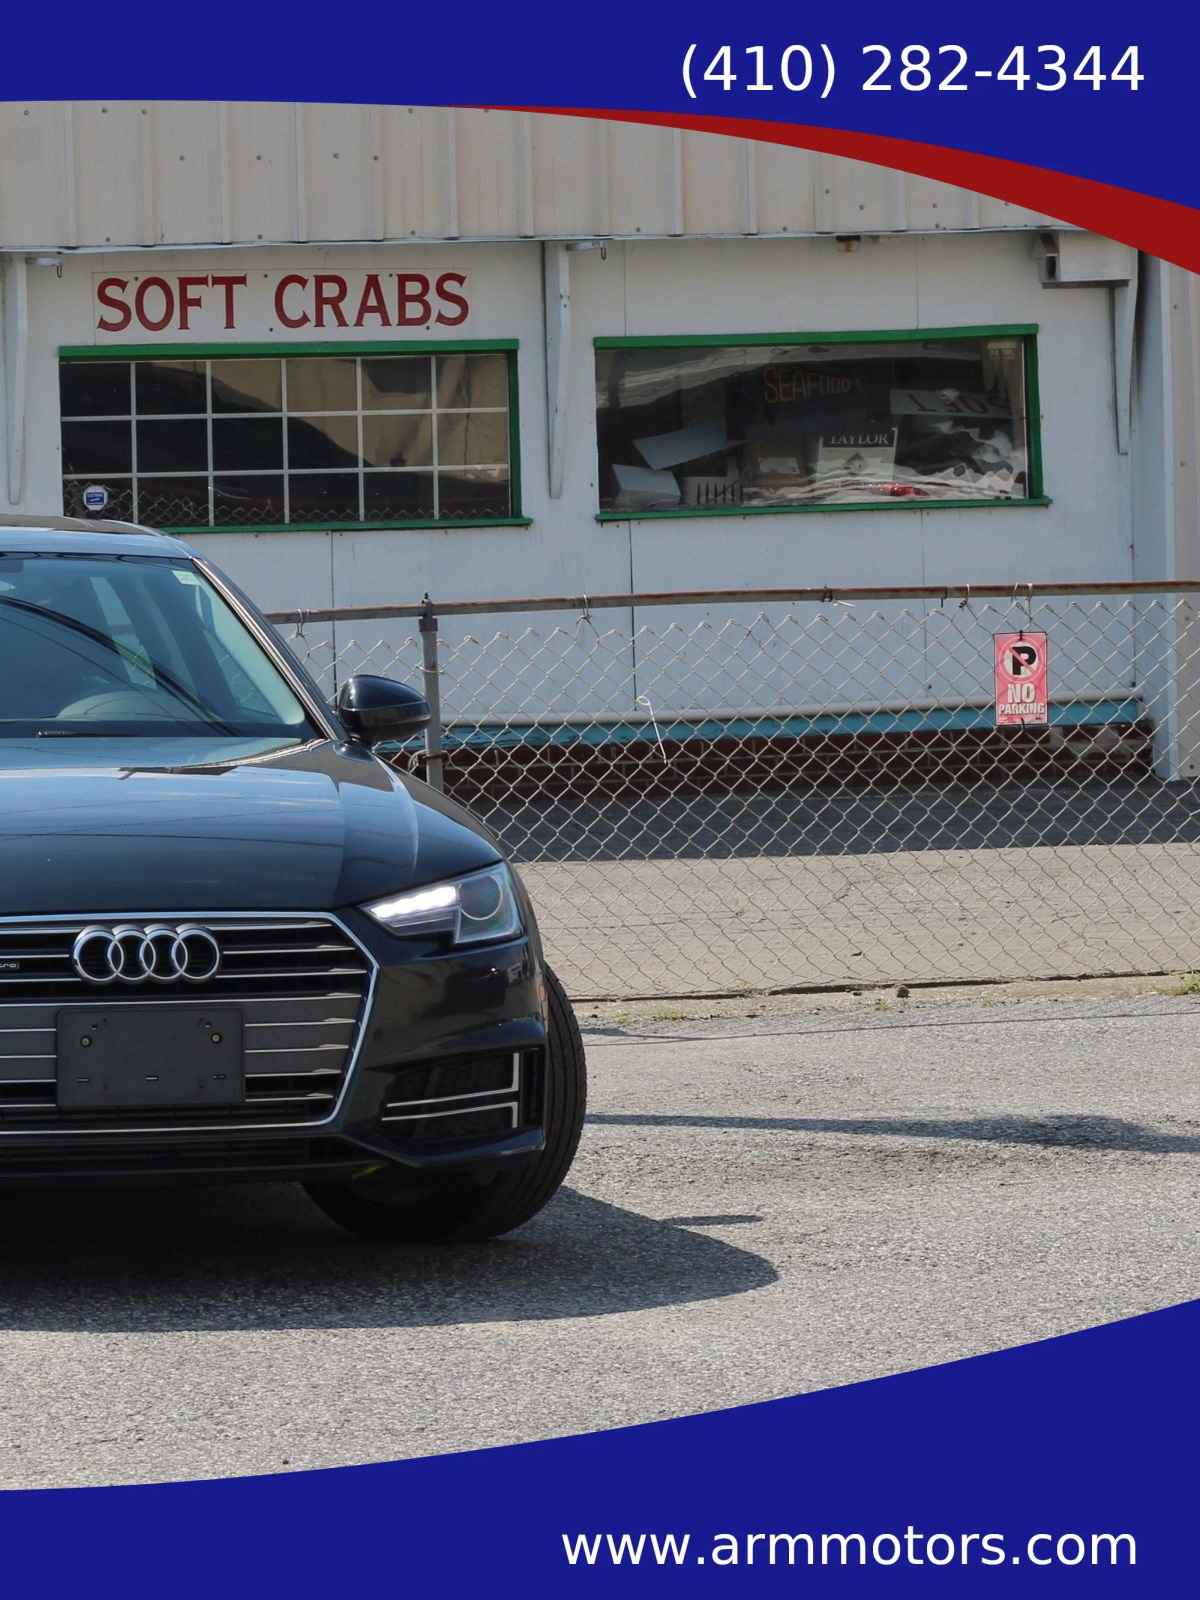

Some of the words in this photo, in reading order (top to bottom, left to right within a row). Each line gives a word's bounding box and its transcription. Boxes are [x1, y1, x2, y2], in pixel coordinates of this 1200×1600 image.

[96, 274, 247, 332] SOFT
[274, 273, 469, 328] CRABS
[1007, 683, 1036, 703] NO
[998, 703, 1045, 715] PARKING
